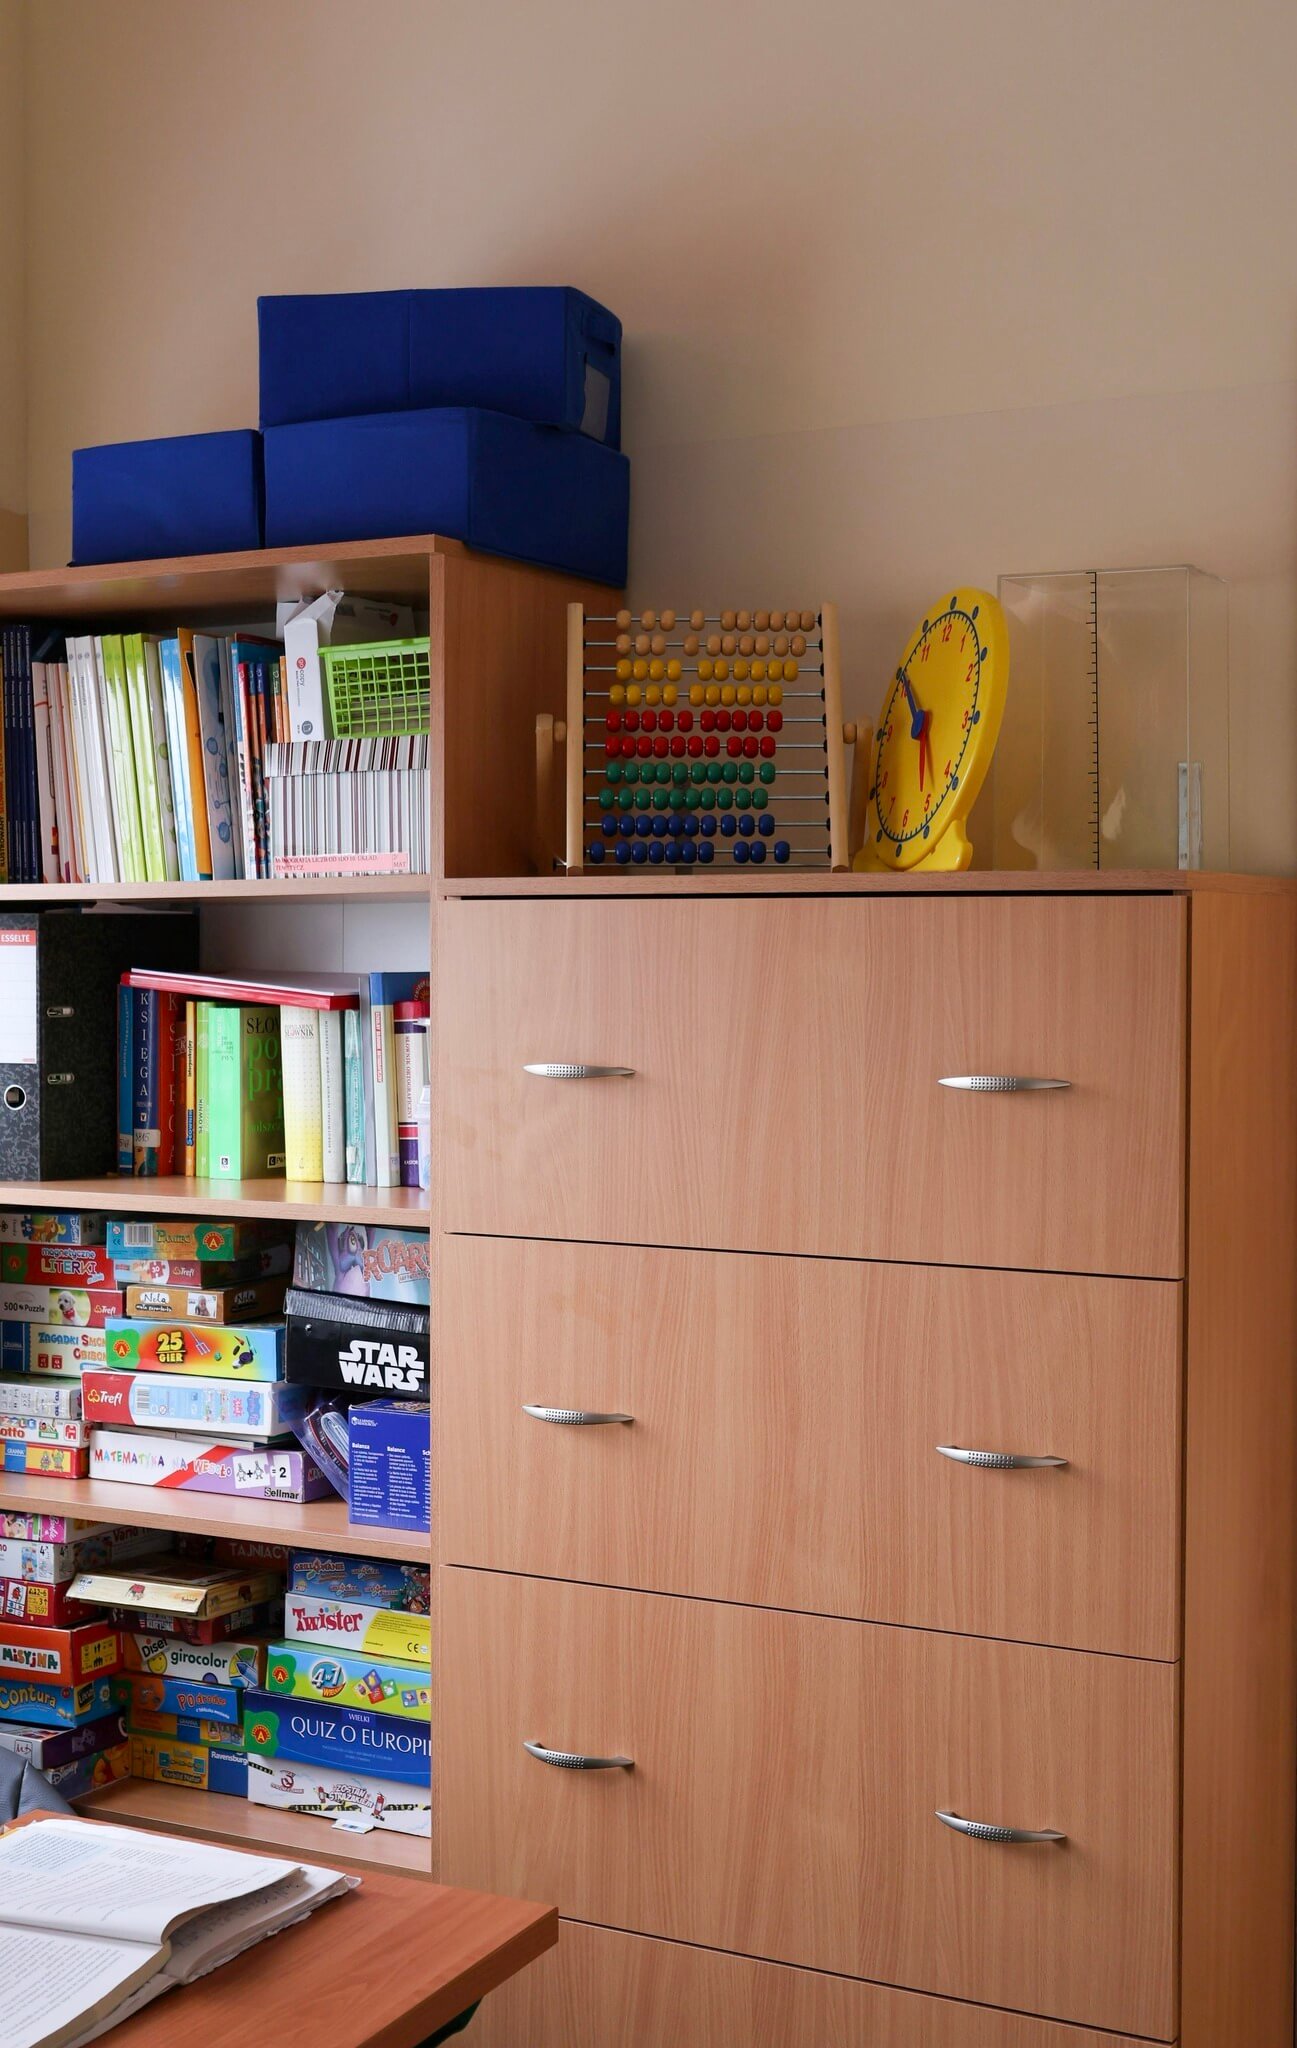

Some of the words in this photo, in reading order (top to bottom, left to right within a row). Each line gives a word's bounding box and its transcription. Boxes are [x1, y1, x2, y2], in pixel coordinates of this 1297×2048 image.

[942, 624, 953, 642] 12
[960, 635, 967, 653] 1
[921, 645, 931, 663] 11
[965, 664, 974, 682] 2
[961, 711, 969, 729] 3
[886, 725, 893, 742] 9
[943, 760, 951, 778] 4
[882, 771, 888, 789] 8
[888, 797, 896, 814] 7
[923, 794, 931, 812] 5
[902, 810, 909, 827] 6
[1, 933, 31, 943] ESSELTE
[140, 992, 149, 1097] KSIĘGA
[41, 1247, 96, 1260] magnetyczne
[41, 1258, 97, 1275] LITERKI
[180, 1267, 194, 1276] Trefl
[144, 1293, 167, 1303] Nela
[3, 1302, 18, 1311] 500
[24, 1304, 45, 1313] Puzzle
[102, 1305, 117, 1316] Trefl
[38, 1332, 79, 1345] ZAGADKI
[157, 1331, 184, 1352] 25
[158, 1352, 184, 1363] GIER
[339, 1340, 424, 1369] STAR
[339, 1361, 424, 1392] WARS
[100, 1390, 123, 1407] Trefl
[279, 1467, 287, 1478] 2
[264, 1487, 300, 1500] Sellmar
[292, 1607, 363, 1632] Twister
[171, 1648, 228, 1668] girocolor
[0, 1684, 57, 1710] Contura
[348, 1713, 370, 1723] WIELKI
[291, 1716, 336, 1740] QUIZ
[341, 1725, 356, 1743] O
